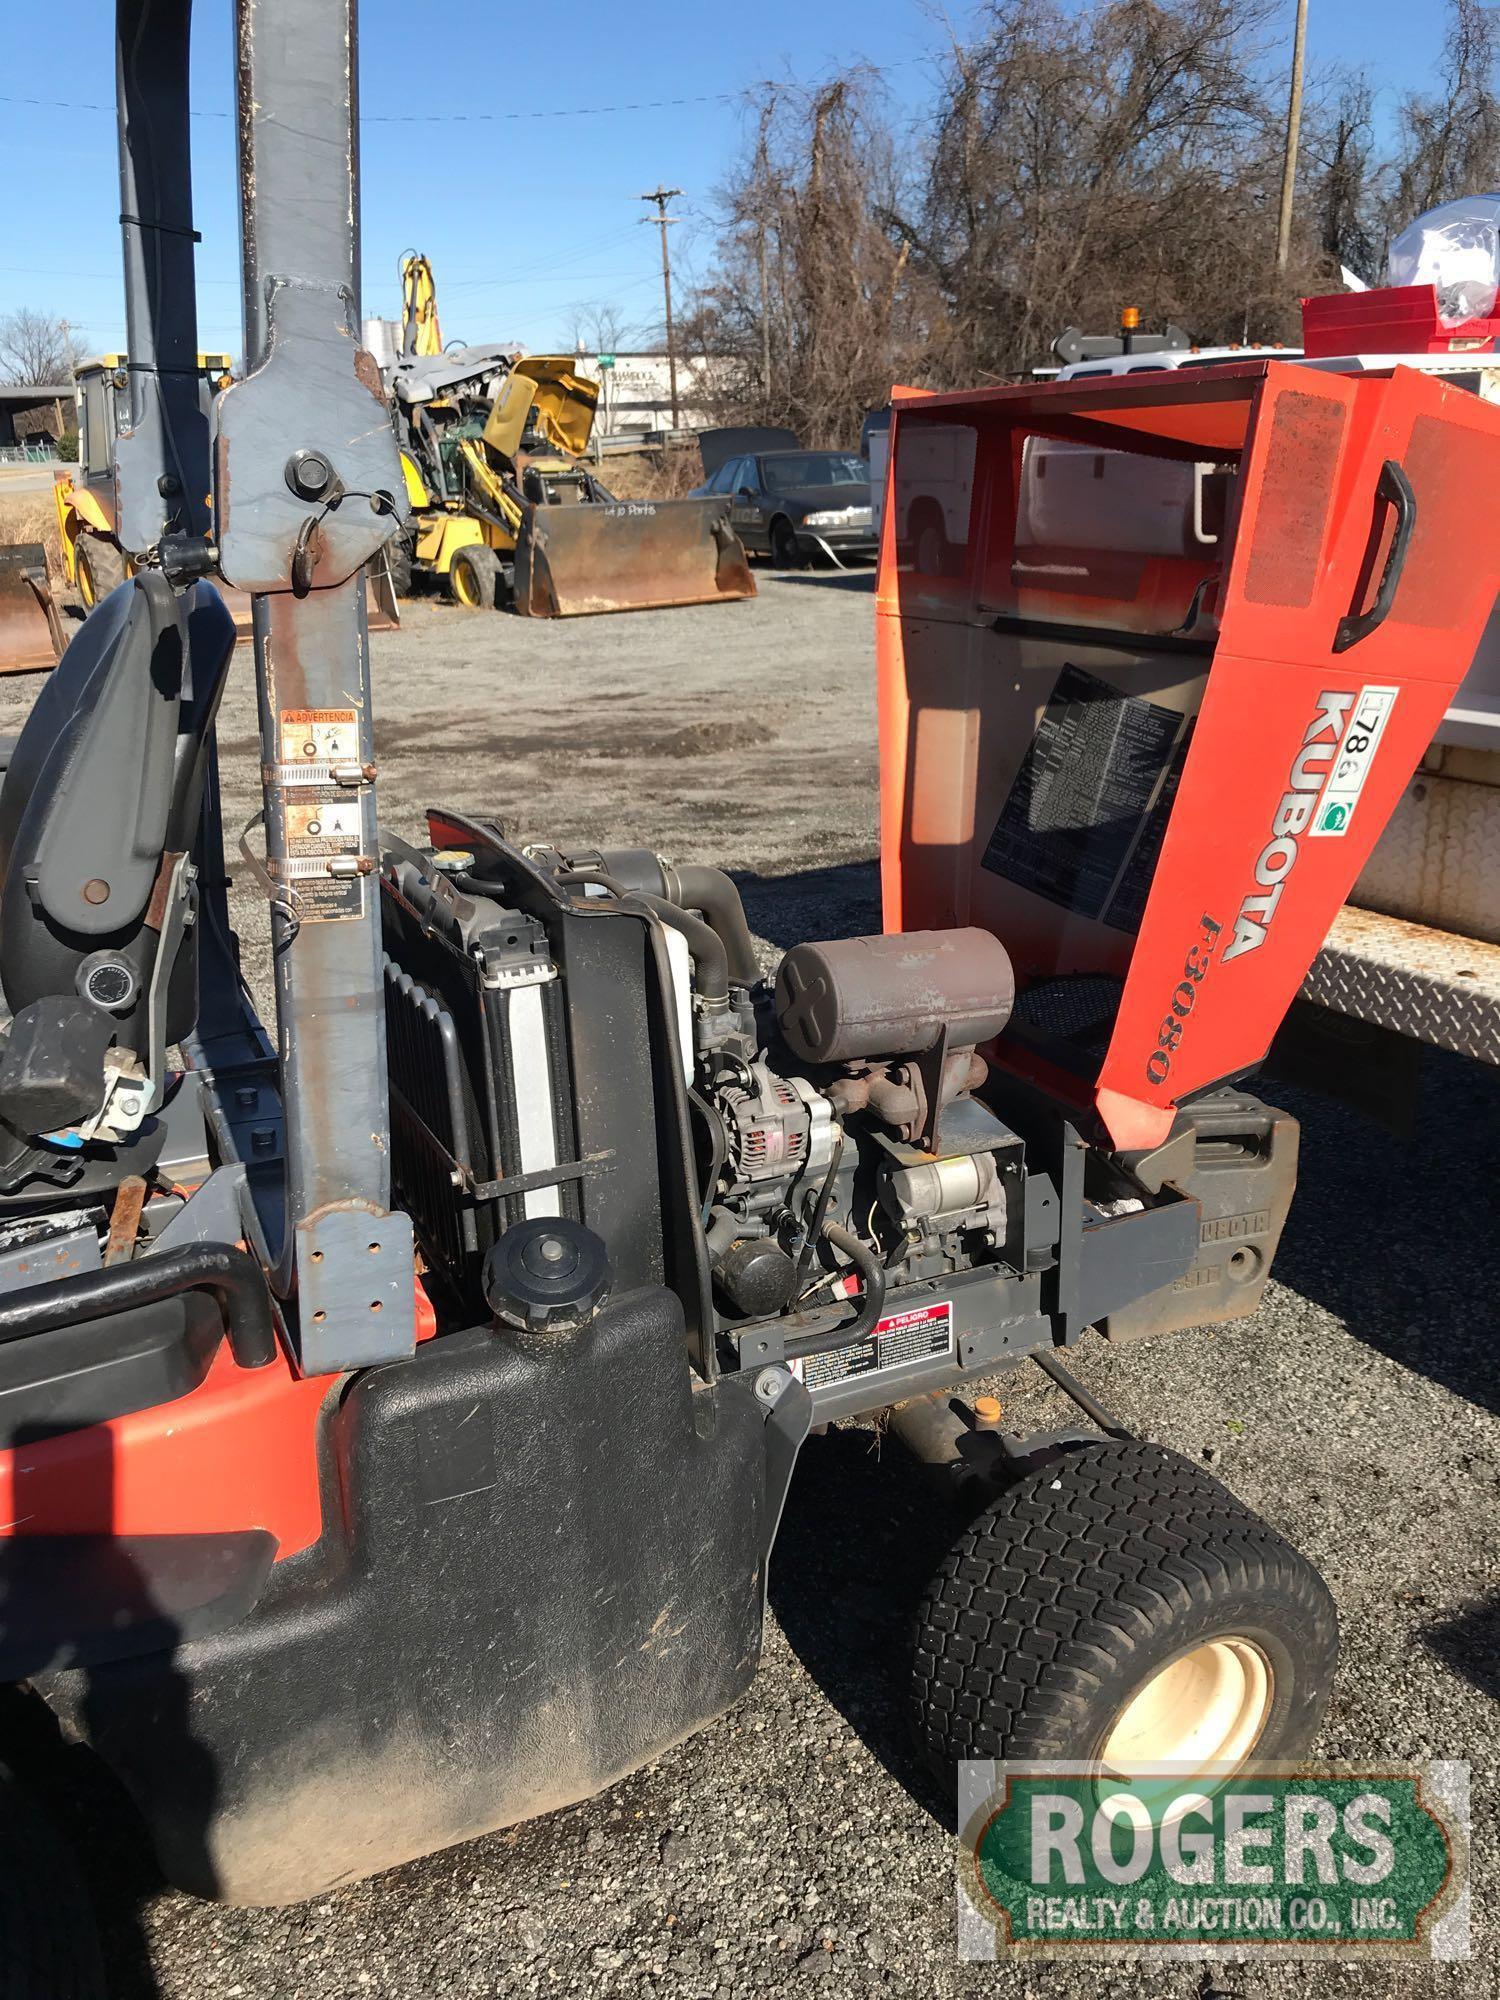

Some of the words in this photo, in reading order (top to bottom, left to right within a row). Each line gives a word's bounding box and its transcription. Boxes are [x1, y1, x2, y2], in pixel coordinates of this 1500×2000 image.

[296, 712, 354, 722] ADVERTENCIA
[1220, 690, 1357, 964] KUBOTA
[1146, 911, 1224, 1085] F3080
[1201, 1214, 1266, 1243] UBOTA
[895, 1311, 929, 1325] PELIGRO
